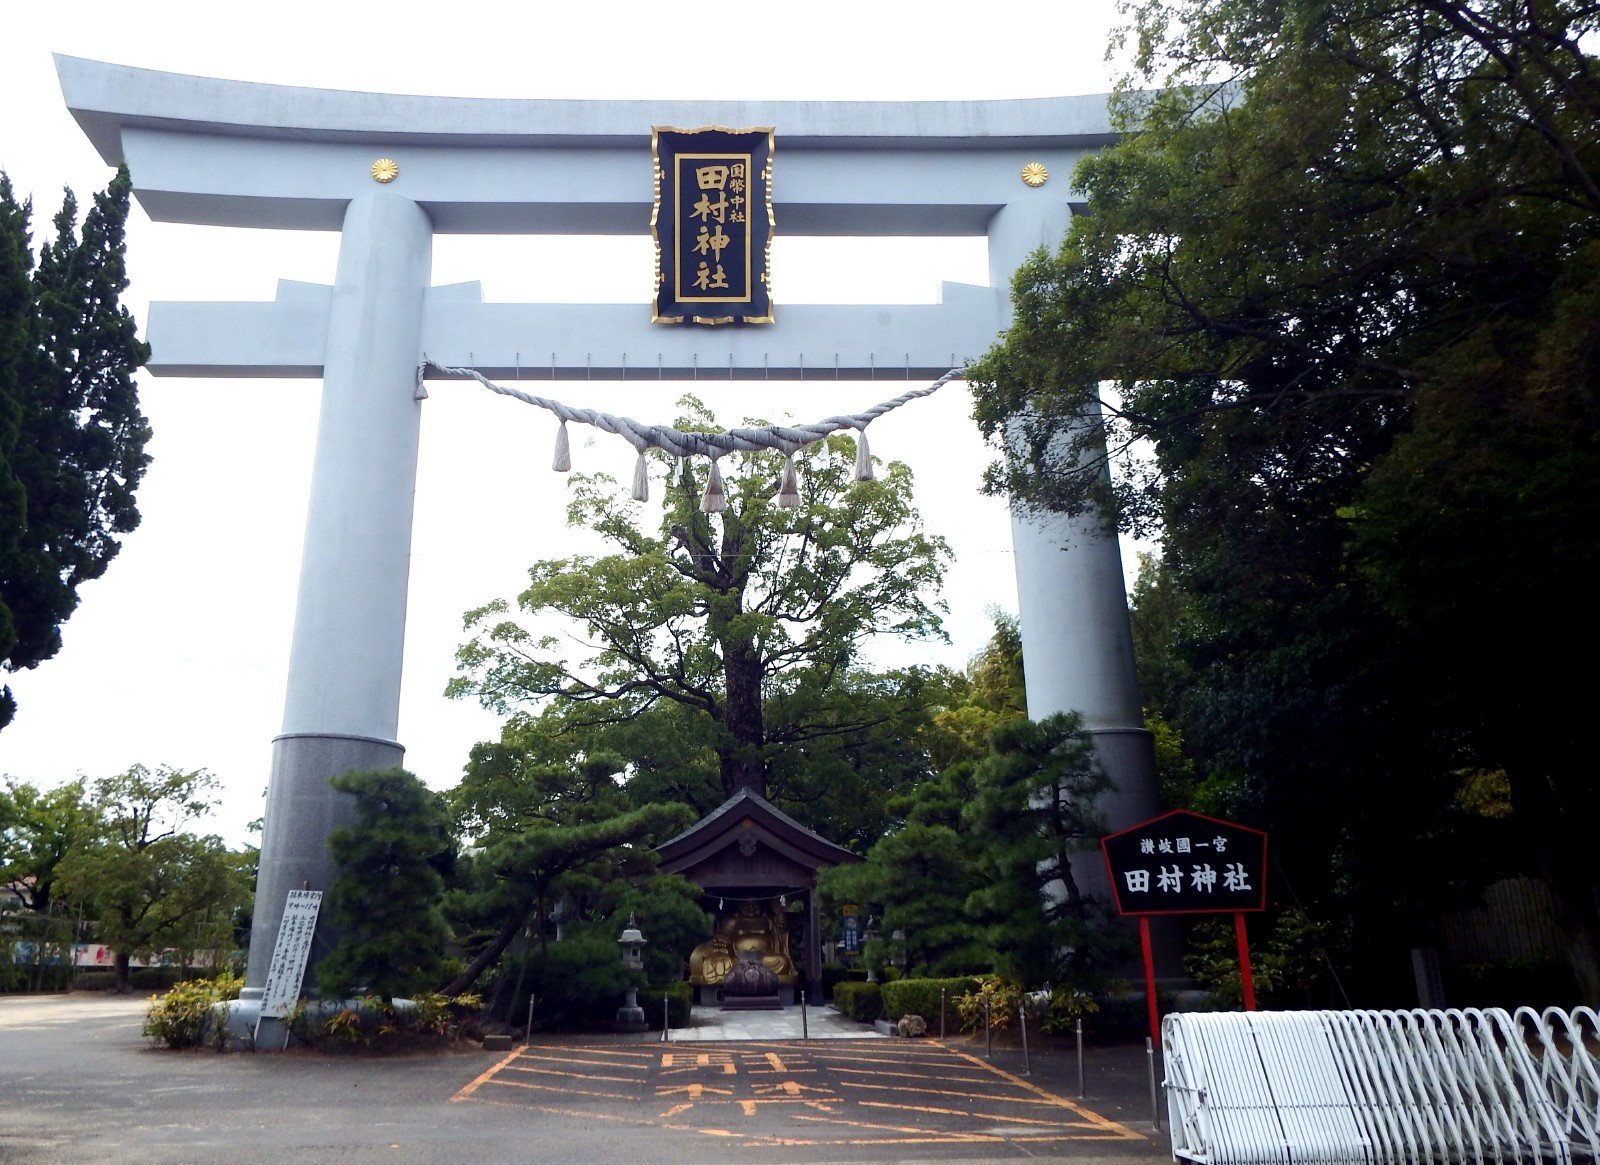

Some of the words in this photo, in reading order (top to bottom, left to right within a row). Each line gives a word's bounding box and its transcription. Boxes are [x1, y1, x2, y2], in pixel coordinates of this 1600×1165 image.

[689, 164, 730, 291] 田村神社
[1123, 862, 1252, 894] 田村神社
